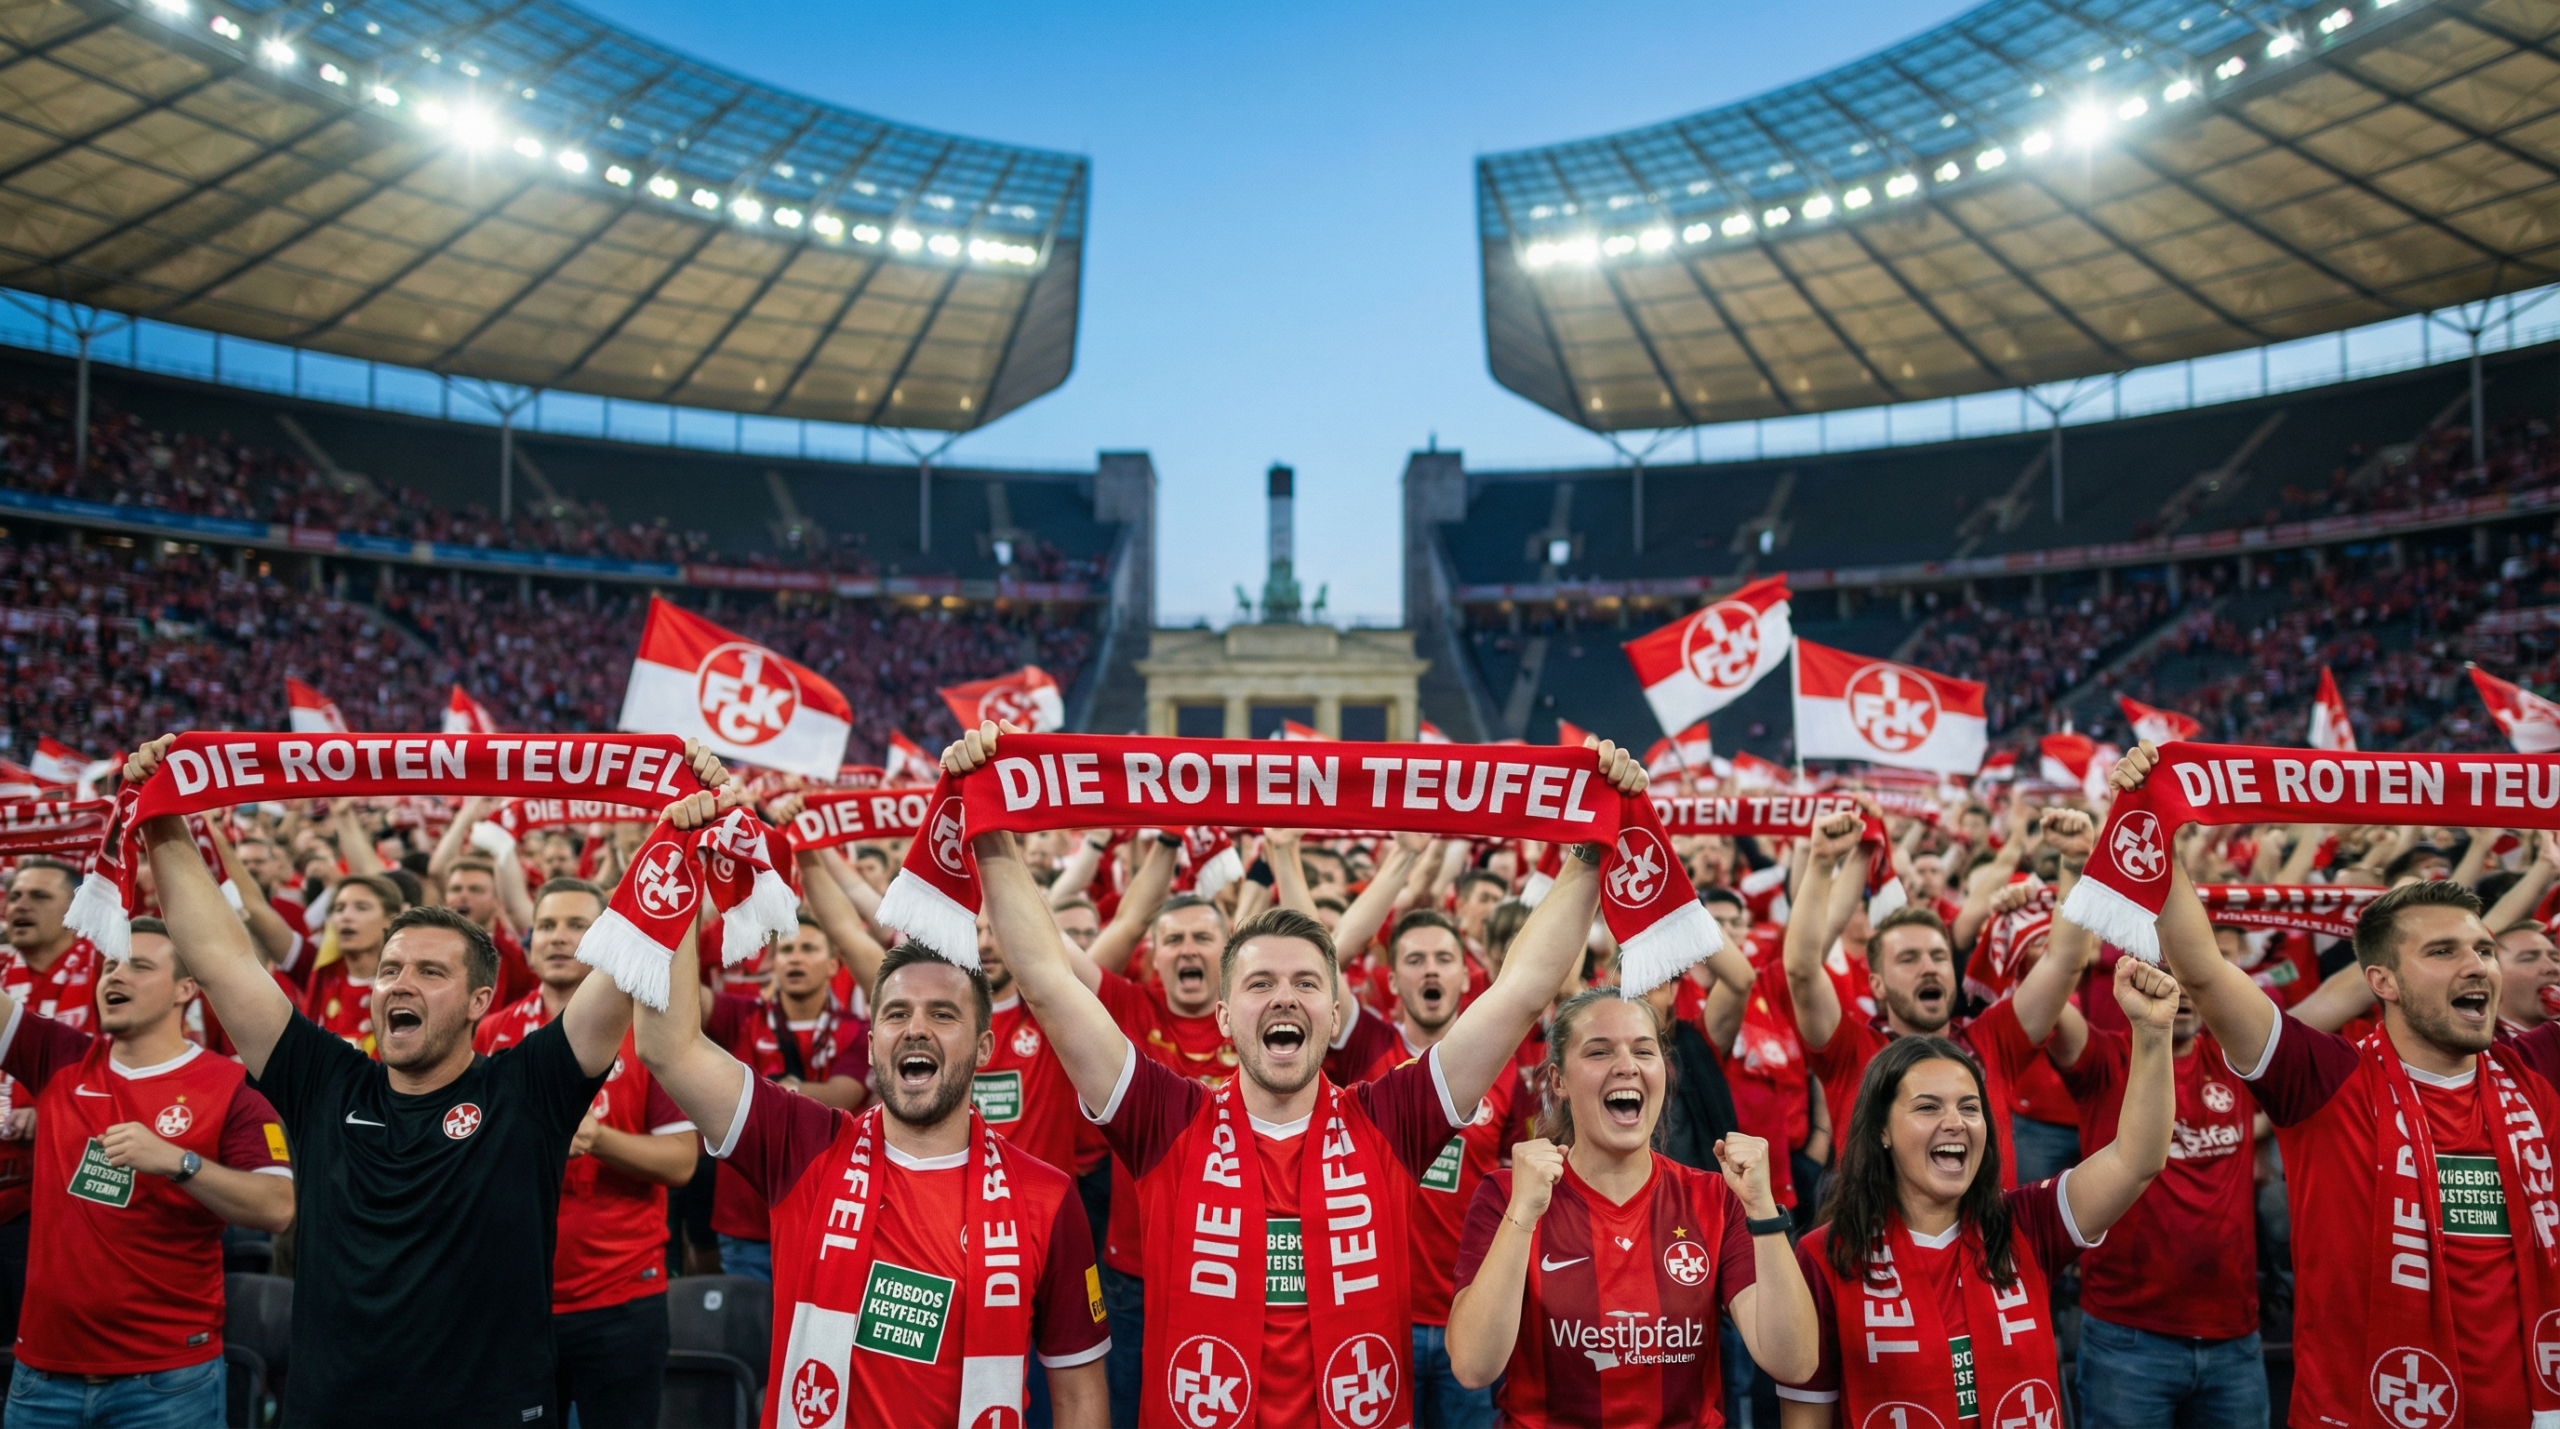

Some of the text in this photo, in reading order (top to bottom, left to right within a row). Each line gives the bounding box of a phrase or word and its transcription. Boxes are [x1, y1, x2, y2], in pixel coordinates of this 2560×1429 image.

[166, 740, 684, 797] DIE ROTEN TEUFEL
[994, 752, 1596, 823] DIE ROTEN TEUFEL
[2172, 760, 2261, 807] DIE
[2274, 759, 2445, 805] ROTEN
[523, 801, 563, 823] DIE
[795, 794, 932, 842] DIE RO
[1654, 798, 1739, 826] OTEN
[1747, 797, 1863, 827] TEUFE
[984, 1220, 1021, 1307] DIE
[1190, 1203, 1242, 1299] DIE
